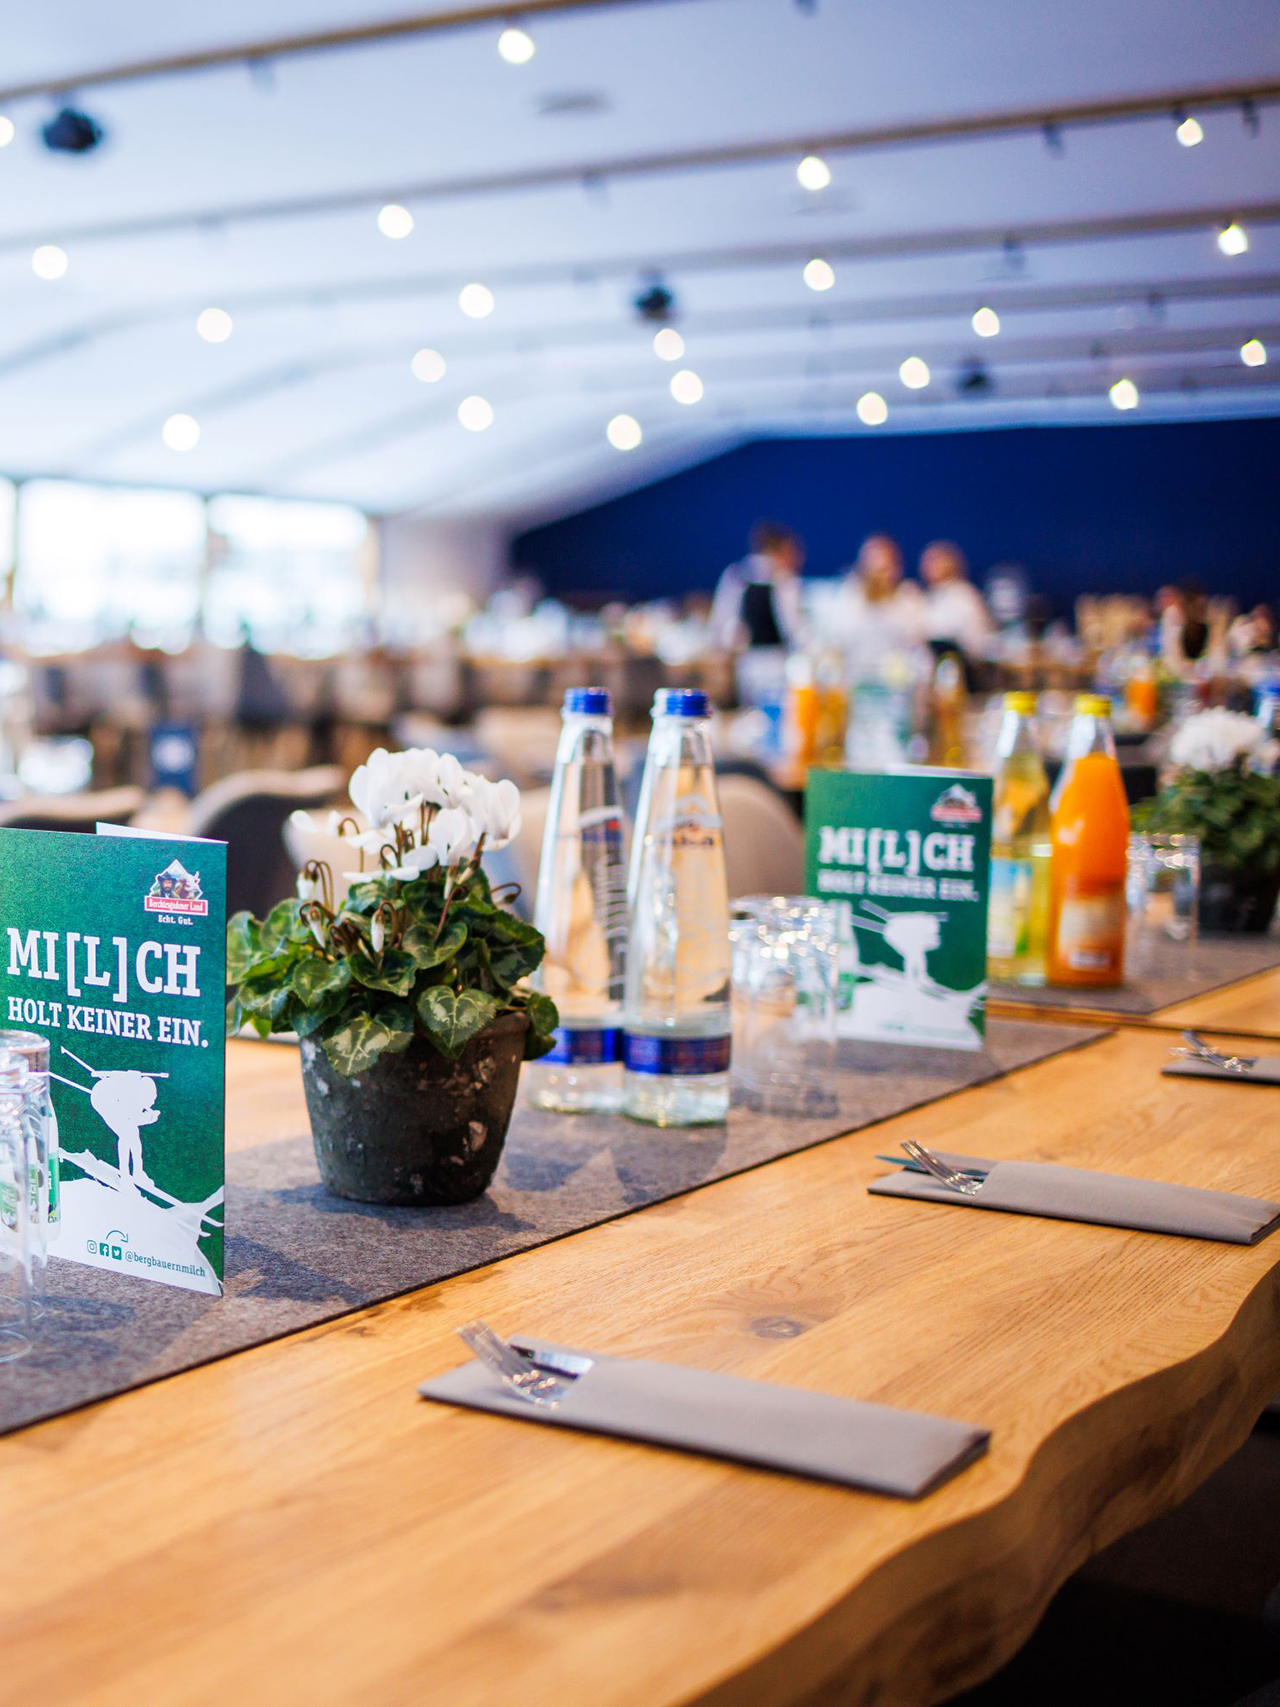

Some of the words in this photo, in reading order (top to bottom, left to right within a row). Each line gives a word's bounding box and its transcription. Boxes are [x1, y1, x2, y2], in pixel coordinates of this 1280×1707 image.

[149, 899, 189, 911] Berchtesgadener
[190, 902, 203, 911] Land
[158, 914, 176, 923] Echt.
[178, 916, 193, 925] Gut.
[7, 927, 201, 1003] MI[L]CH
[7, 996, 62, 1027] HOLT
[67, 1004, 152, 1041] KEINER
[157, 1016, 209, 1048] EIN.
[125, 1250, 205, 1277] @bergbauernmilch
